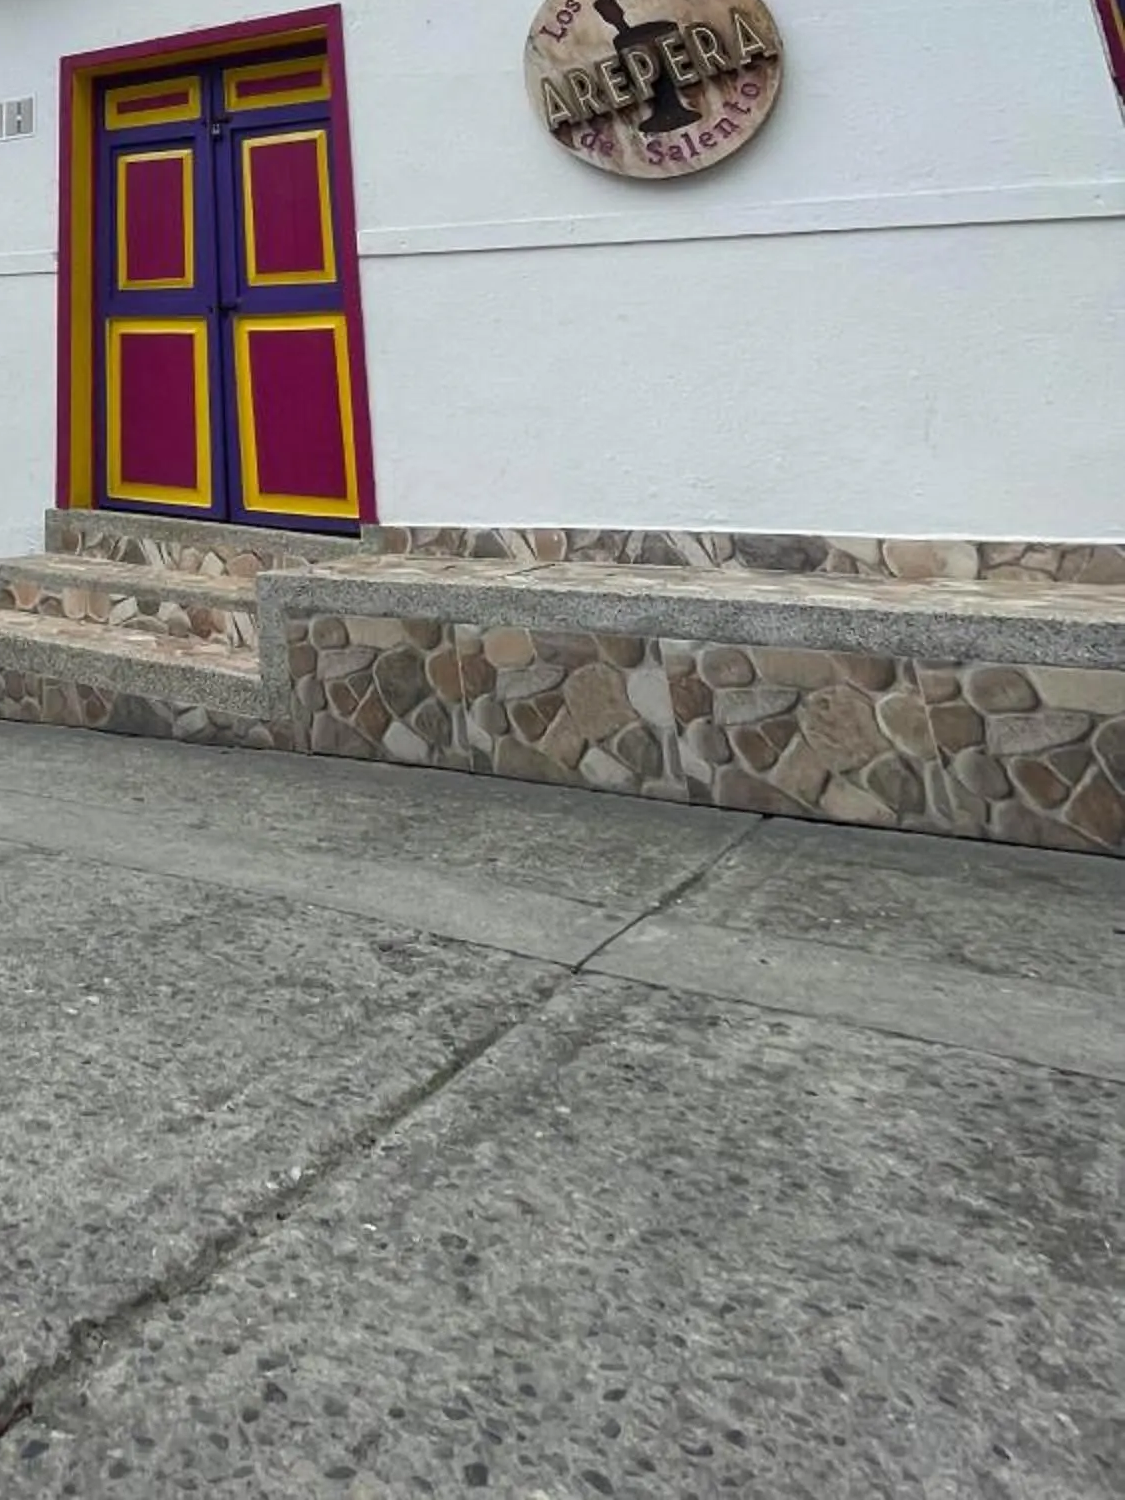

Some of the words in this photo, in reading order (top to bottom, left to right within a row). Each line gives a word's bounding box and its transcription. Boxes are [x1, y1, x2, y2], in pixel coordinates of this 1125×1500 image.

[541, 7, 775, 130] AREPERA
[580, 125, 614, 157] de
[644, 81, 761, 165] Salento
